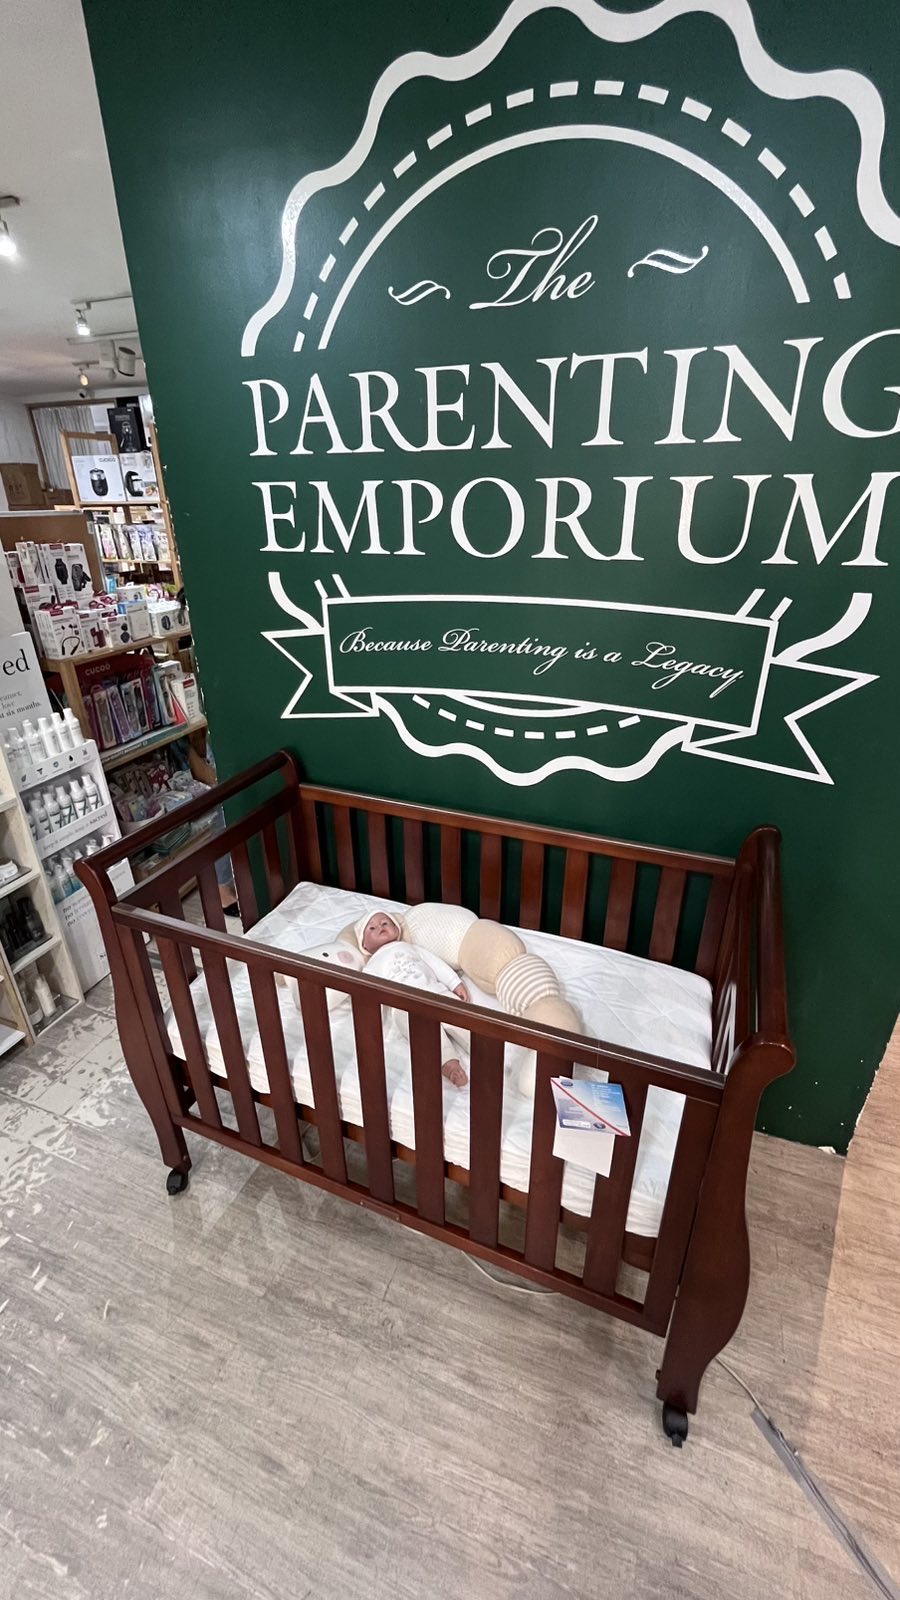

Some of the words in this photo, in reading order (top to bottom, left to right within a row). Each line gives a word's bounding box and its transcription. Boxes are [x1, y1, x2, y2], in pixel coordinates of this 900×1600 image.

[468, 214, 599, 310] The
[241, 328, 900, 457] PARENTING
[250, 471, 900, 567] EMPORIUM
[338, 626, 432, 654] Because
[437, 627, 568, 676] Parenting
[574, 641, 598, 660] is
[603, 650, 622, 664] a
[631, 641, 744, 699] Legacy
